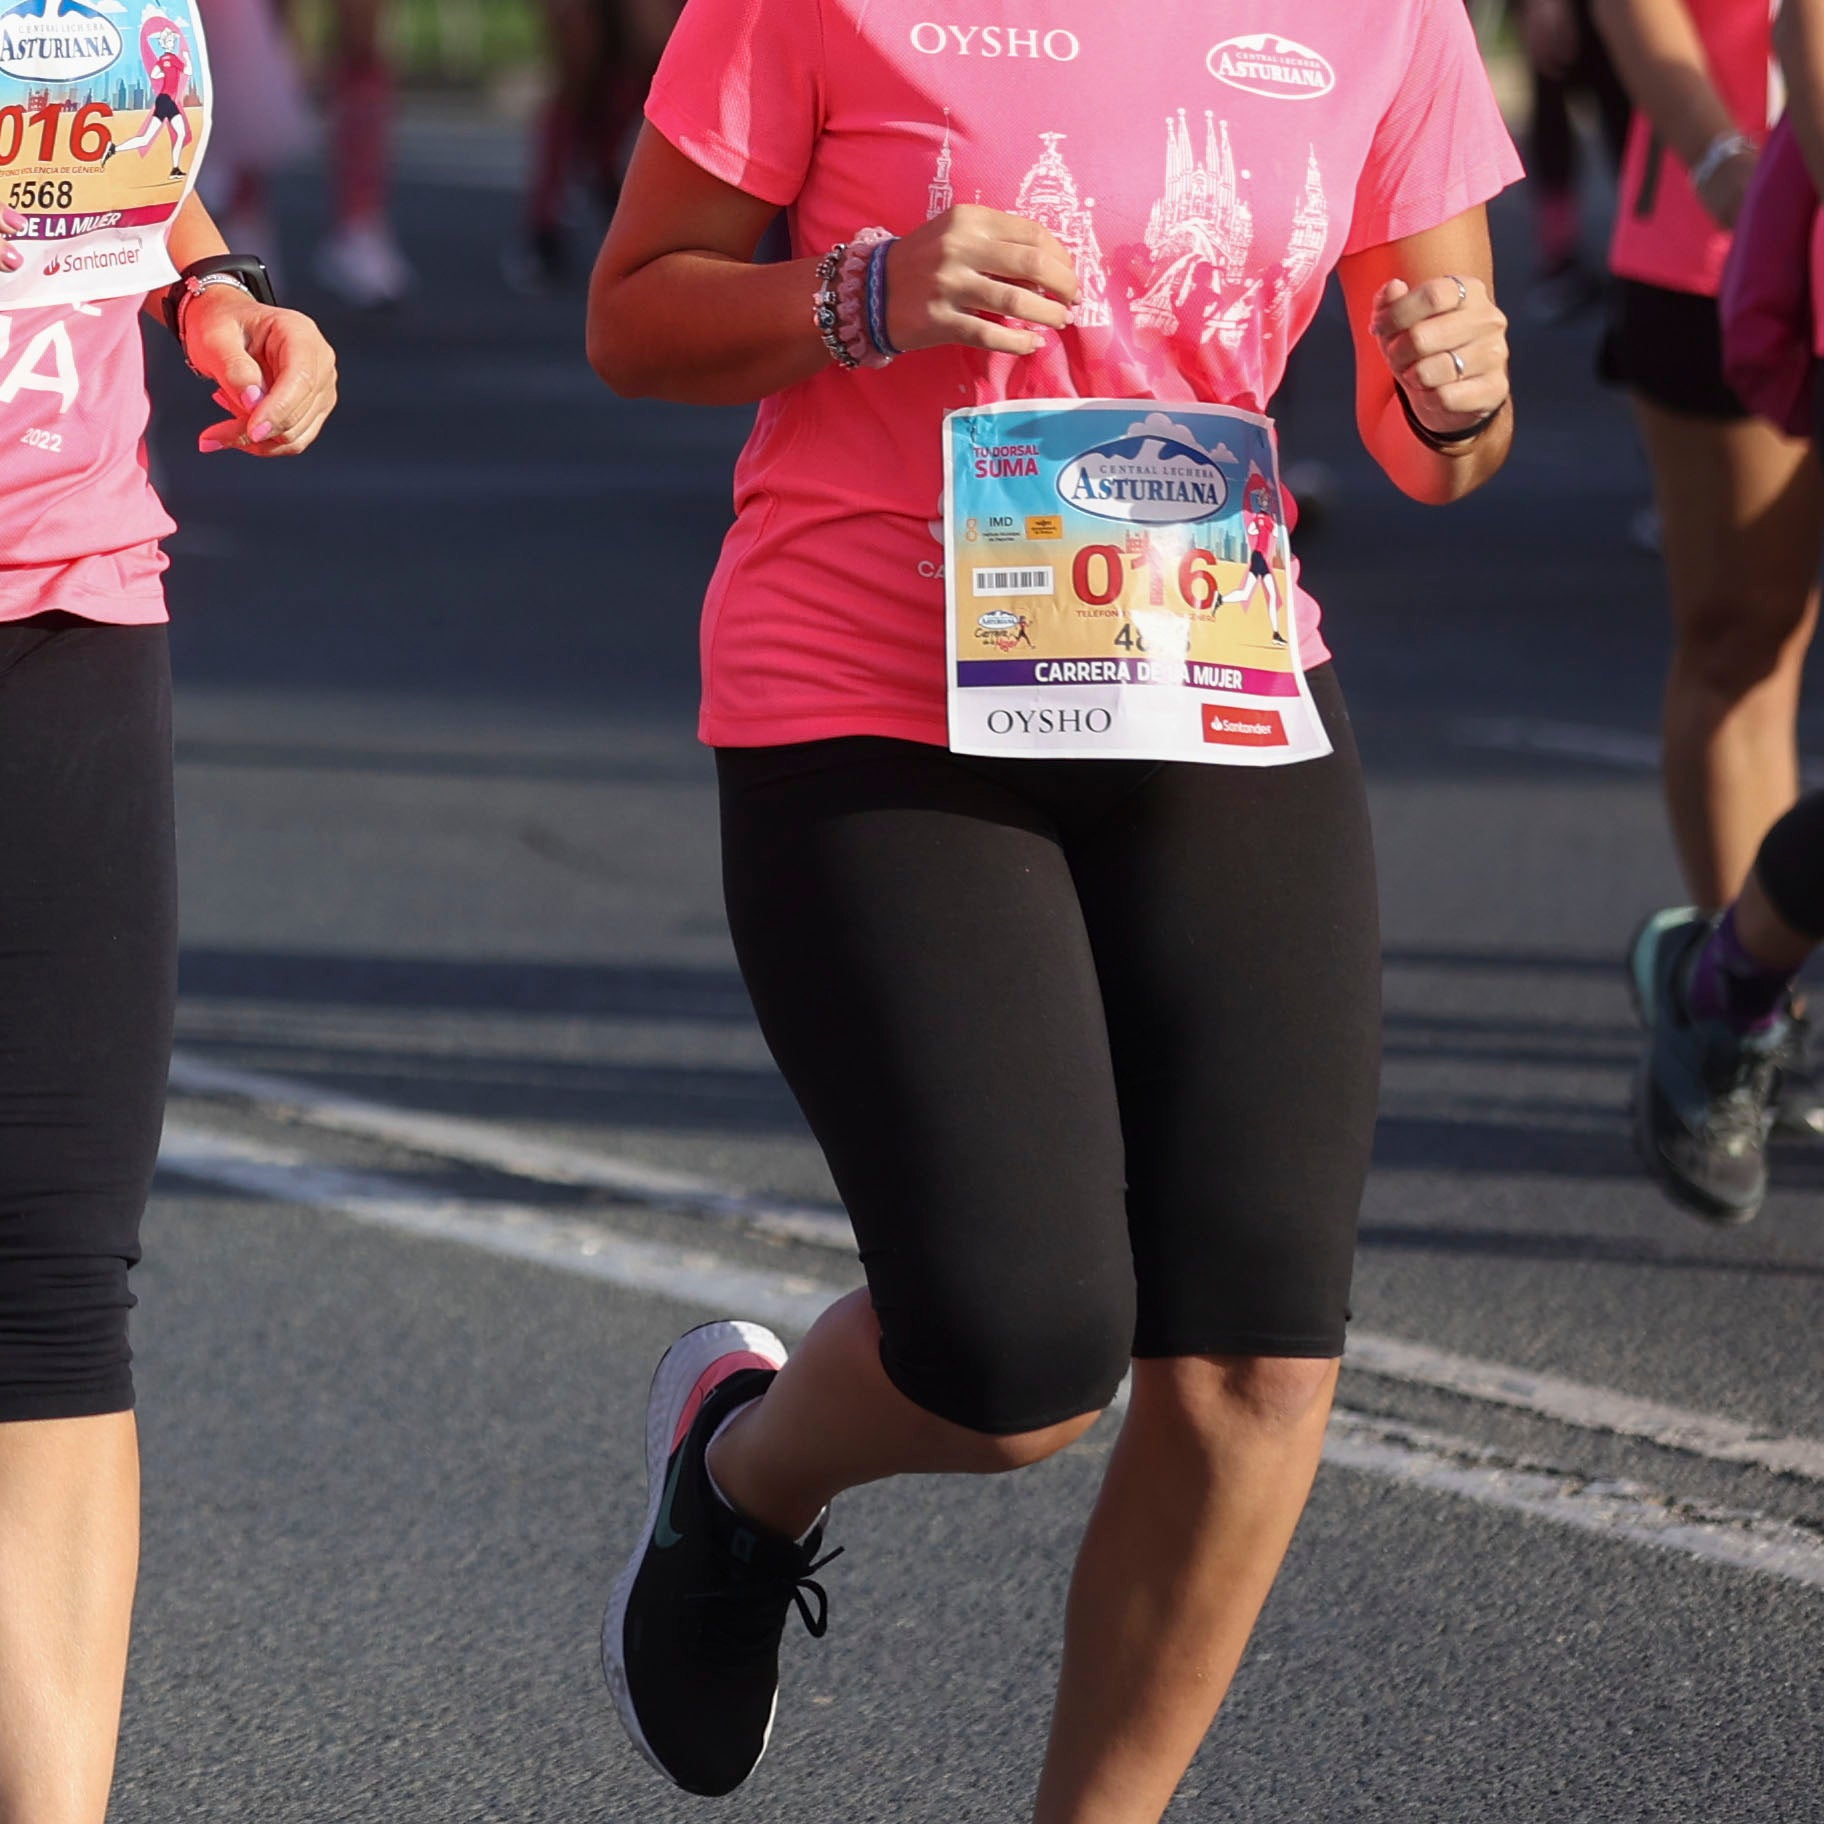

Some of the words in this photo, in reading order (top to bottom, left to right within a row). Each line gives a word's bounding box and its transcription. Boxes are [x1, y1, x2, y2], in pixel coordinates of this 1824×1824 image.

[910, 22, 1080, 62] OYSHO
[1219, 52, 1326, 88] ASTURIANA
[8, 180, 73, 209] 5568
[45, 217, 66, 237] LA
[63, 247, 141, 273] Santander
[20, 427, 62, 453] 2022
[991, 444, 1040, 458] DORSAL
[975, 457, 1040, 478] SUMA
[1099, 465, 1158, 475] CENTRAL
[1071, 467, 1219, 505] ASTURIANA
[989, 516, 1013, 527] IMD
[1072, 544, 1218, 610] 016
[1077, 608, 1120, 618] TELÉFON
[1035, 661, 1131, 683] CARRERA
[1193, 664, 1243, 690] MUJER
[987, 707, 1112, 734] OYSHO
[1223, 719, 1272, 735] Santander
